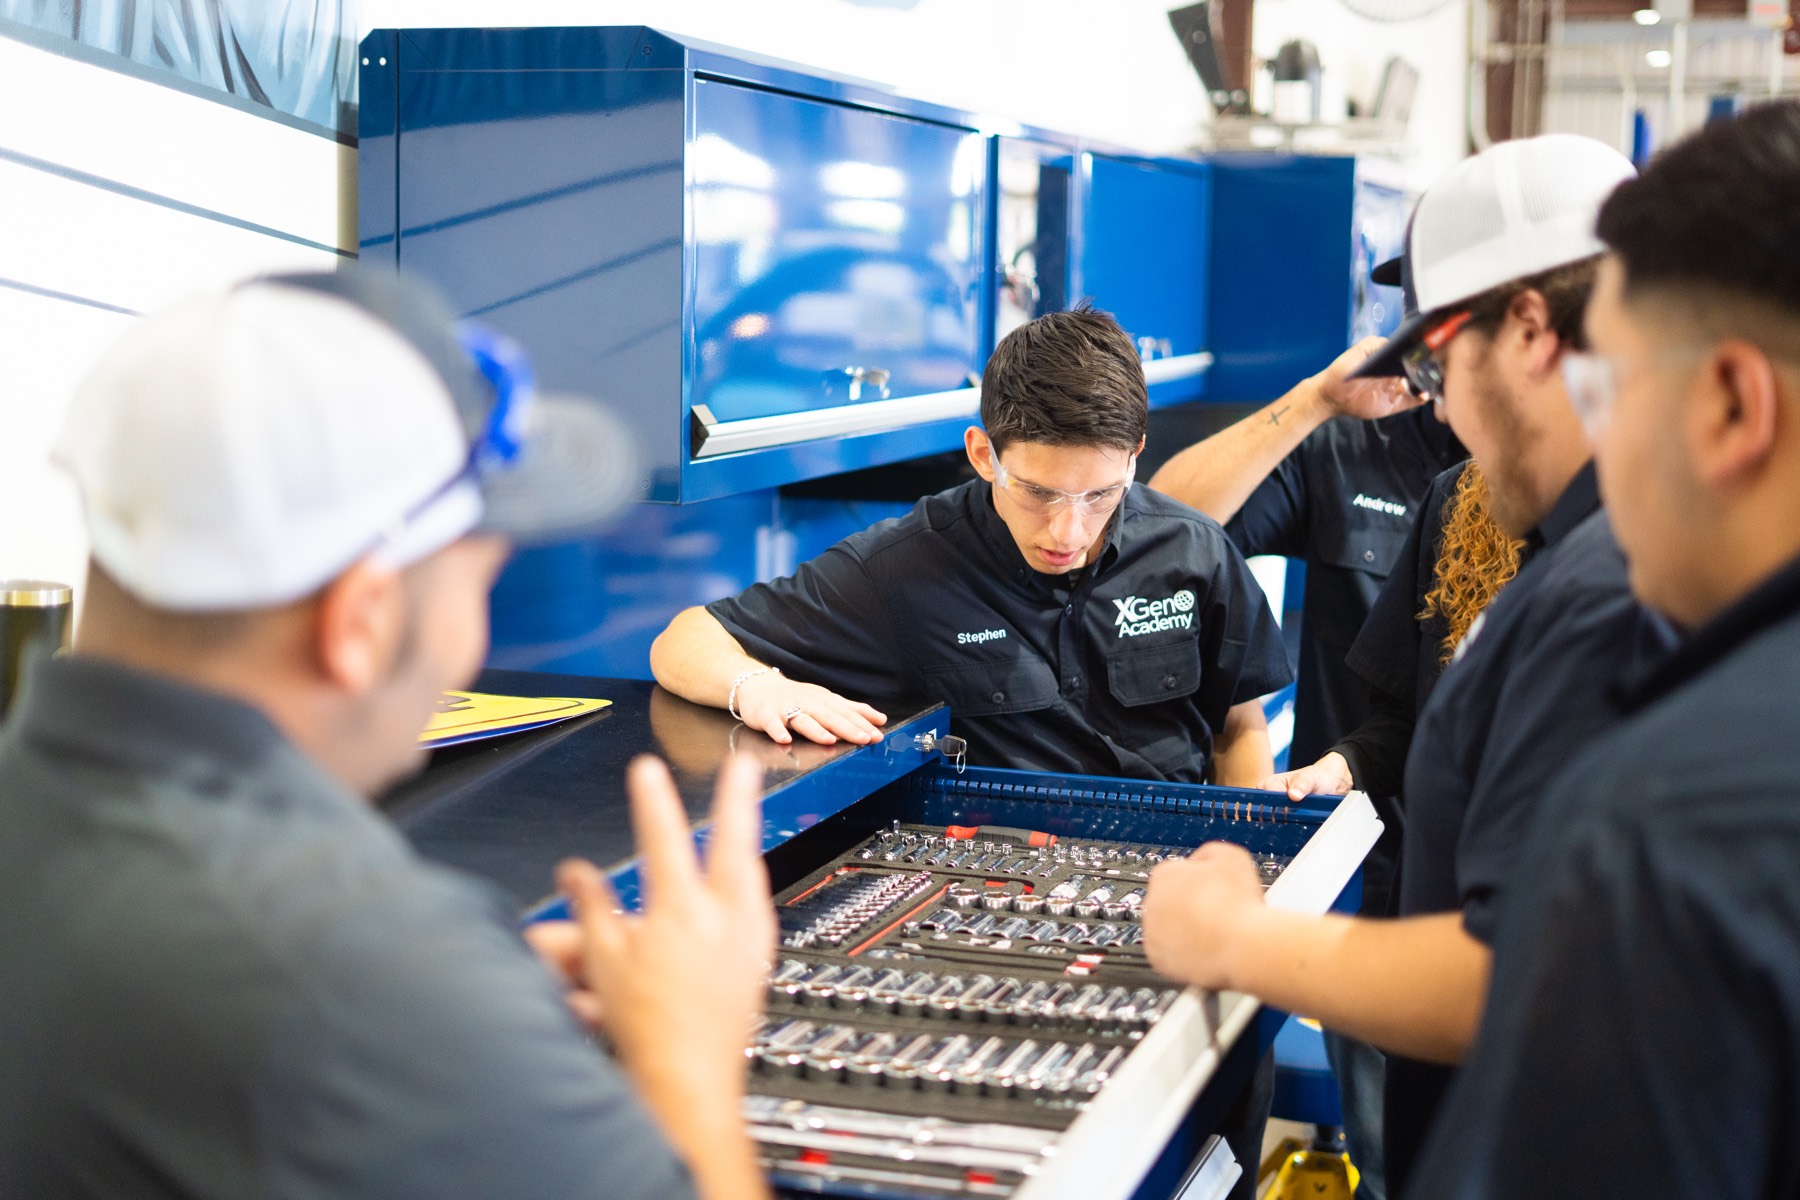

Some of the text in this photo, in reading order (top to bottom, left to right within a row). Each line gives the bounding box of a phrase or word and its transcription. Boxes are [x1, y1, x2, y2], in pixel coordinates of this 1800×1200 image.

[1353, 493, 1406, 516] Andrew
[957, 628, 1006, 644] Stephen
[1118, 612, 1193, 638] Academy
